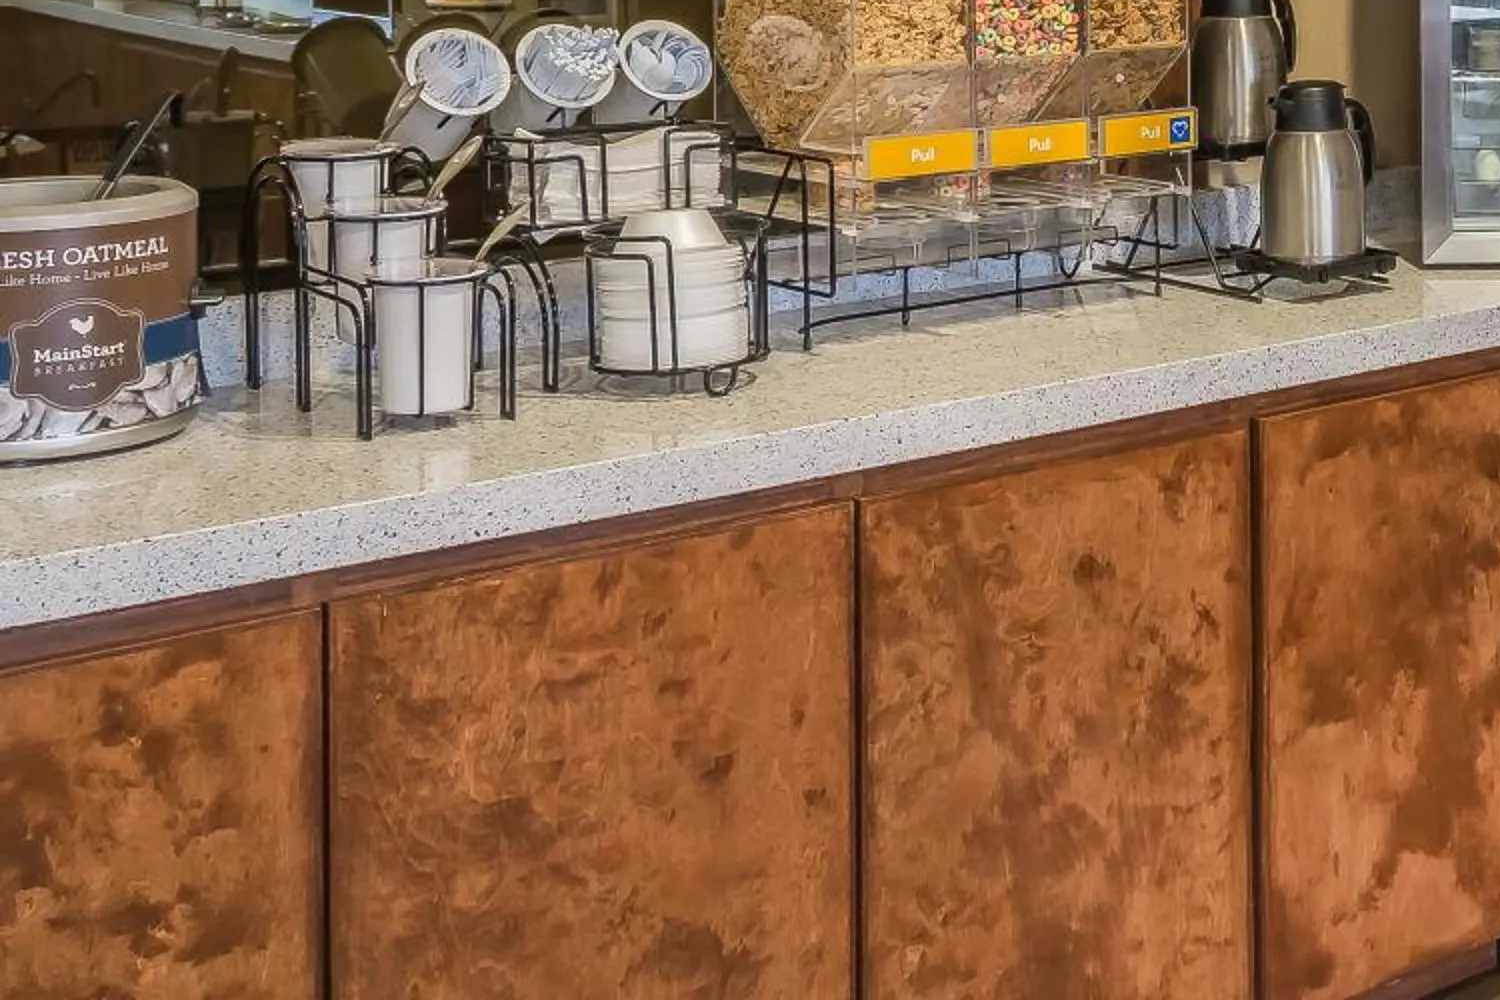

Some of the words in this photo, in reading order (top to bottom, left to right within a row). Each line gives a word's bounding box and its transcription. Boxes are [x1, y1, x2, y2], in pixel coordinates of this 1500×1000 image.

[1140, 125, 1161, 139] Pull
[1029, 138, 1052, 153] Pull
[911, 149, 935, 162] Pull
[0, 249, 55, 269] ESH
[63, 236, 169, 264] OATMEAL
[30, 272, 72, 285] Home
[114, 263, 139, 277] Like
[33, 342, 125, 363] MainStart
